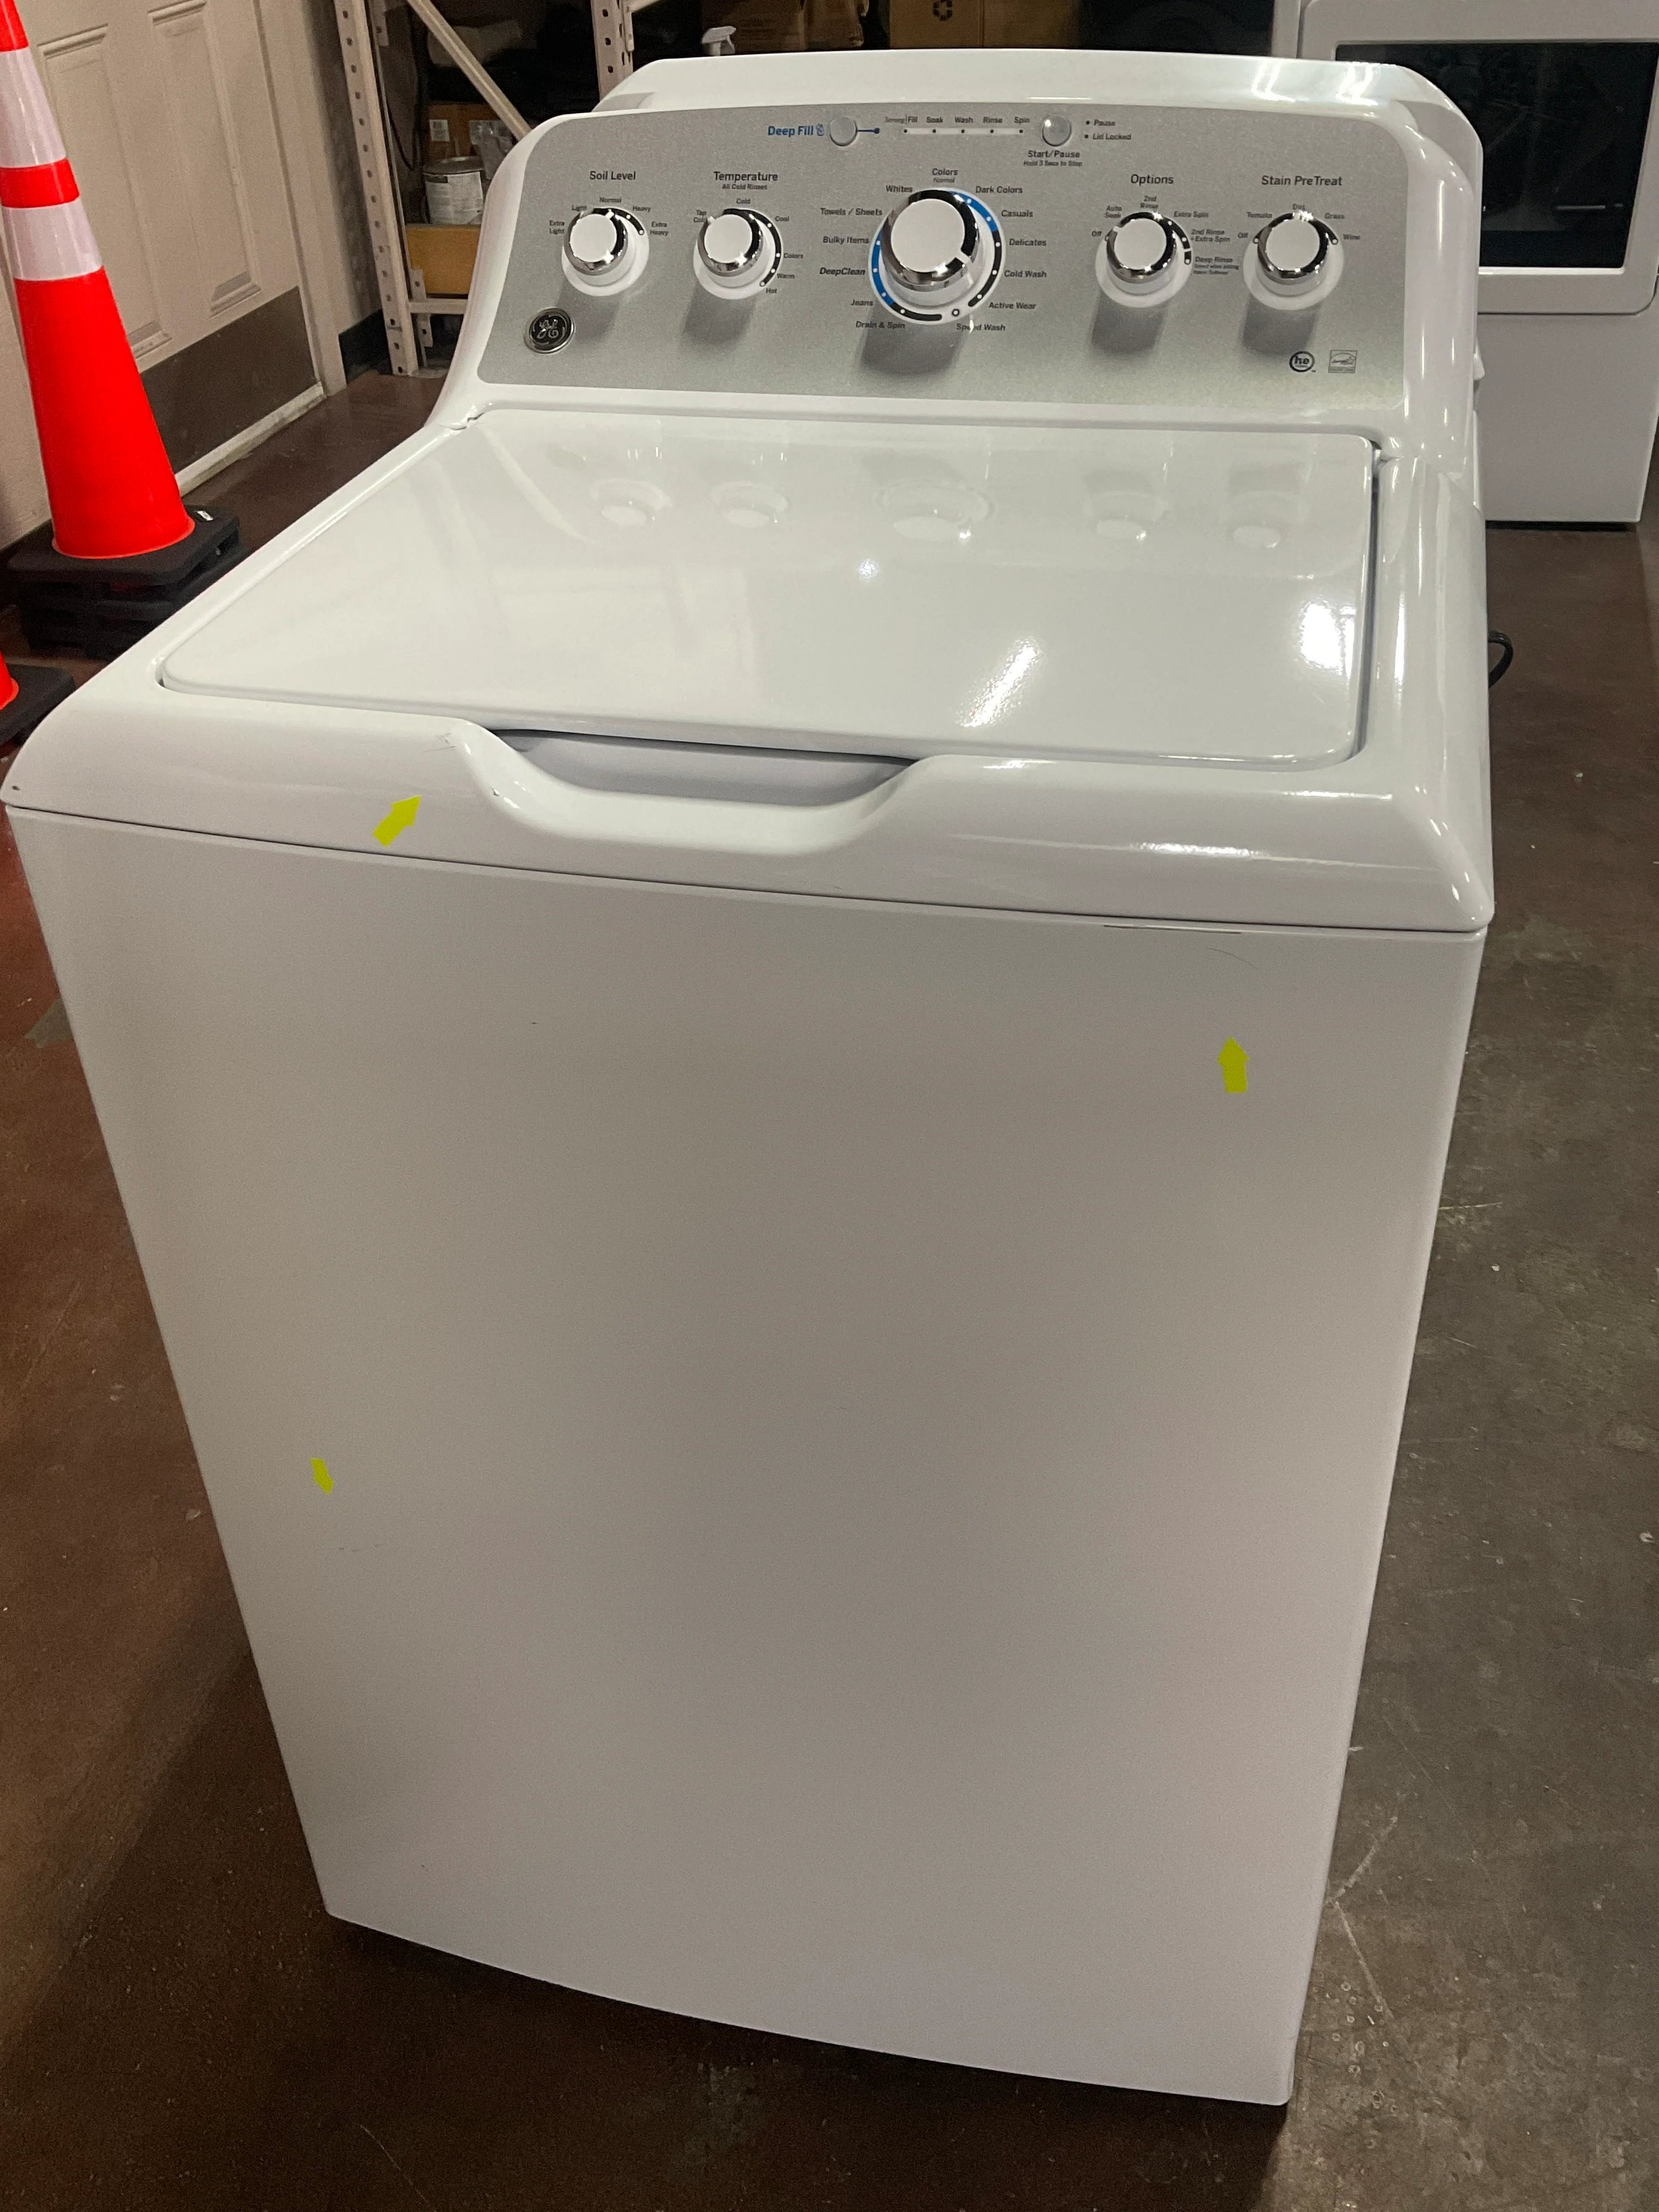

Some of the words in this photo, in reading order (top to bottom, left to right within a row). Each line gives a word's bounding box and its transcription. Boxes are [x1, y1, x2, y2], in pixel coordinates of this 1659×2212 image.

[768, 126, 795, 137] Deep
[798, 126, 814, 136] Fill
[589, 171, 608, 180] Soil
[611, 171, 636, 180] Level
[714, 172, 778, 183] Temperature
[1131, 174, 1174, 186] Options
[1262, 176, 1291, 185] Stain
[823, 236, 845, 244] Bulky
[820, 267, 865, 276] DeepClean
[989, 301, 1014, 309] Active
[956, 323, 981, 331] Sped
[1295, 356, 1310, 364] he
